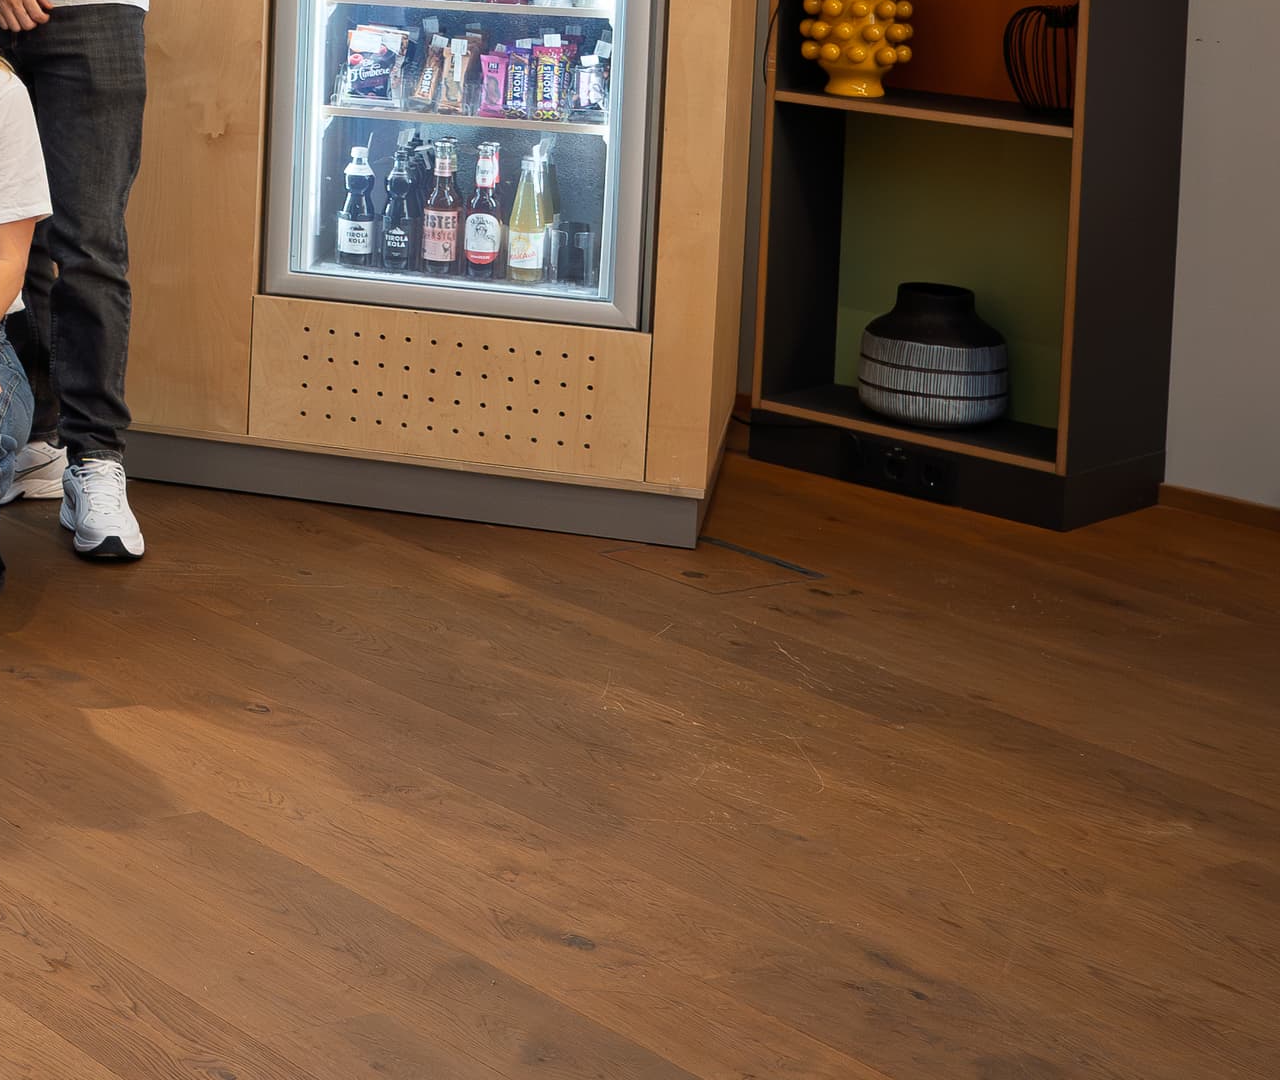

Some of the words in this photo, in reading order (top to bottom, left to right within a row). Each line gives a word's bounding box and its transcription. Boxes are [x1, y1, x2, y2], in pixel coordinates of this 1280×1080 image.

[513, 65, 522, 99] ADONIS
[543, 65, 552, 100] ADONIS
[423, 215, 457, 229] ISTEE
